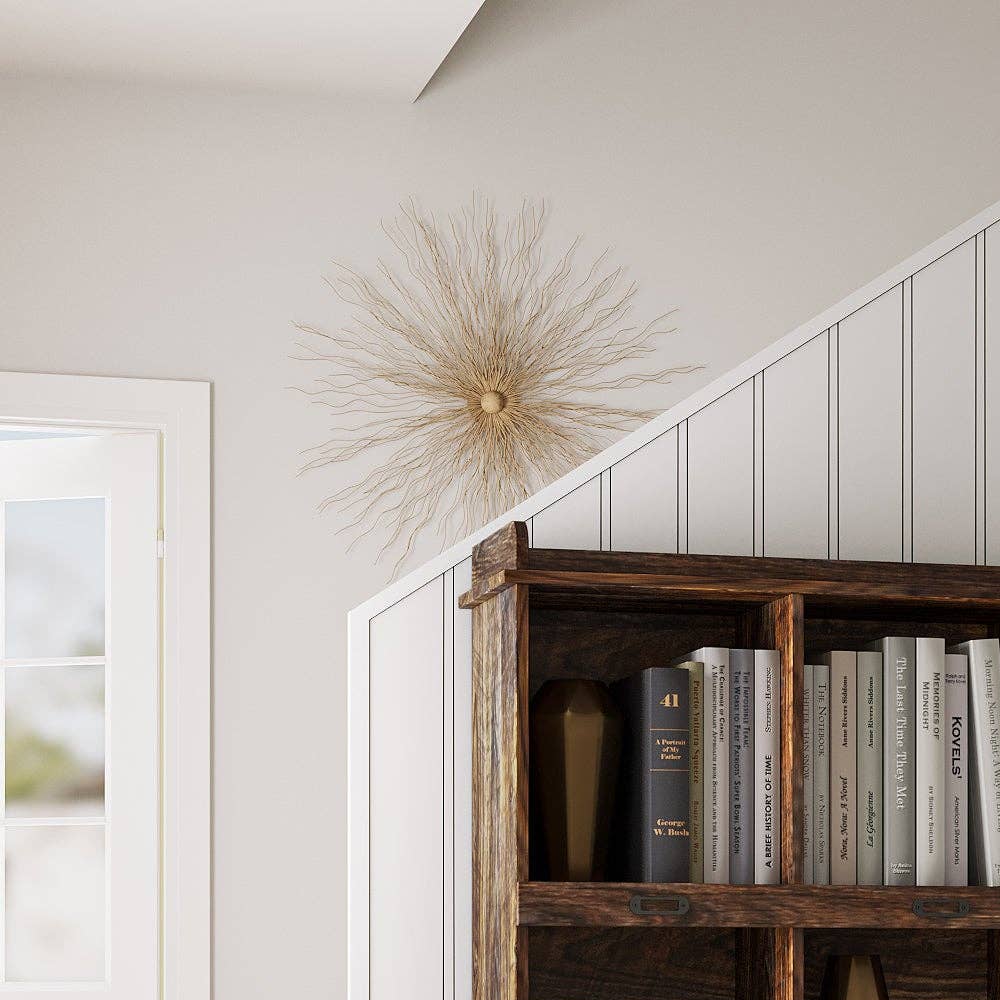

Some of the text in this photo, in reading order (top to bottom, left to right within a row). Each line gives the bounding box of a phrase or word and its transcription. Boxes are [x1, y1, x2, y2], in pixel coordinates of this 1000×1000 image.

[984, 660, 993, 698] Morning
[659, 694, 680, 708] 41
[988, 702, 996, 725] Noon
[895, 657, 906, 809] The Last Time They Met
[988, 728, 999, 758] Night:
[692, 749, 700, 784] Squeeze
[993, 759, 1000, 767] A
[765, 778, 772, 790] OF
[992, 770, 1000, 788] Way
[656, 818, 686, 828] George
[654, 828, 690, 836] W. Bush
[765, 860, 772, 868] A
